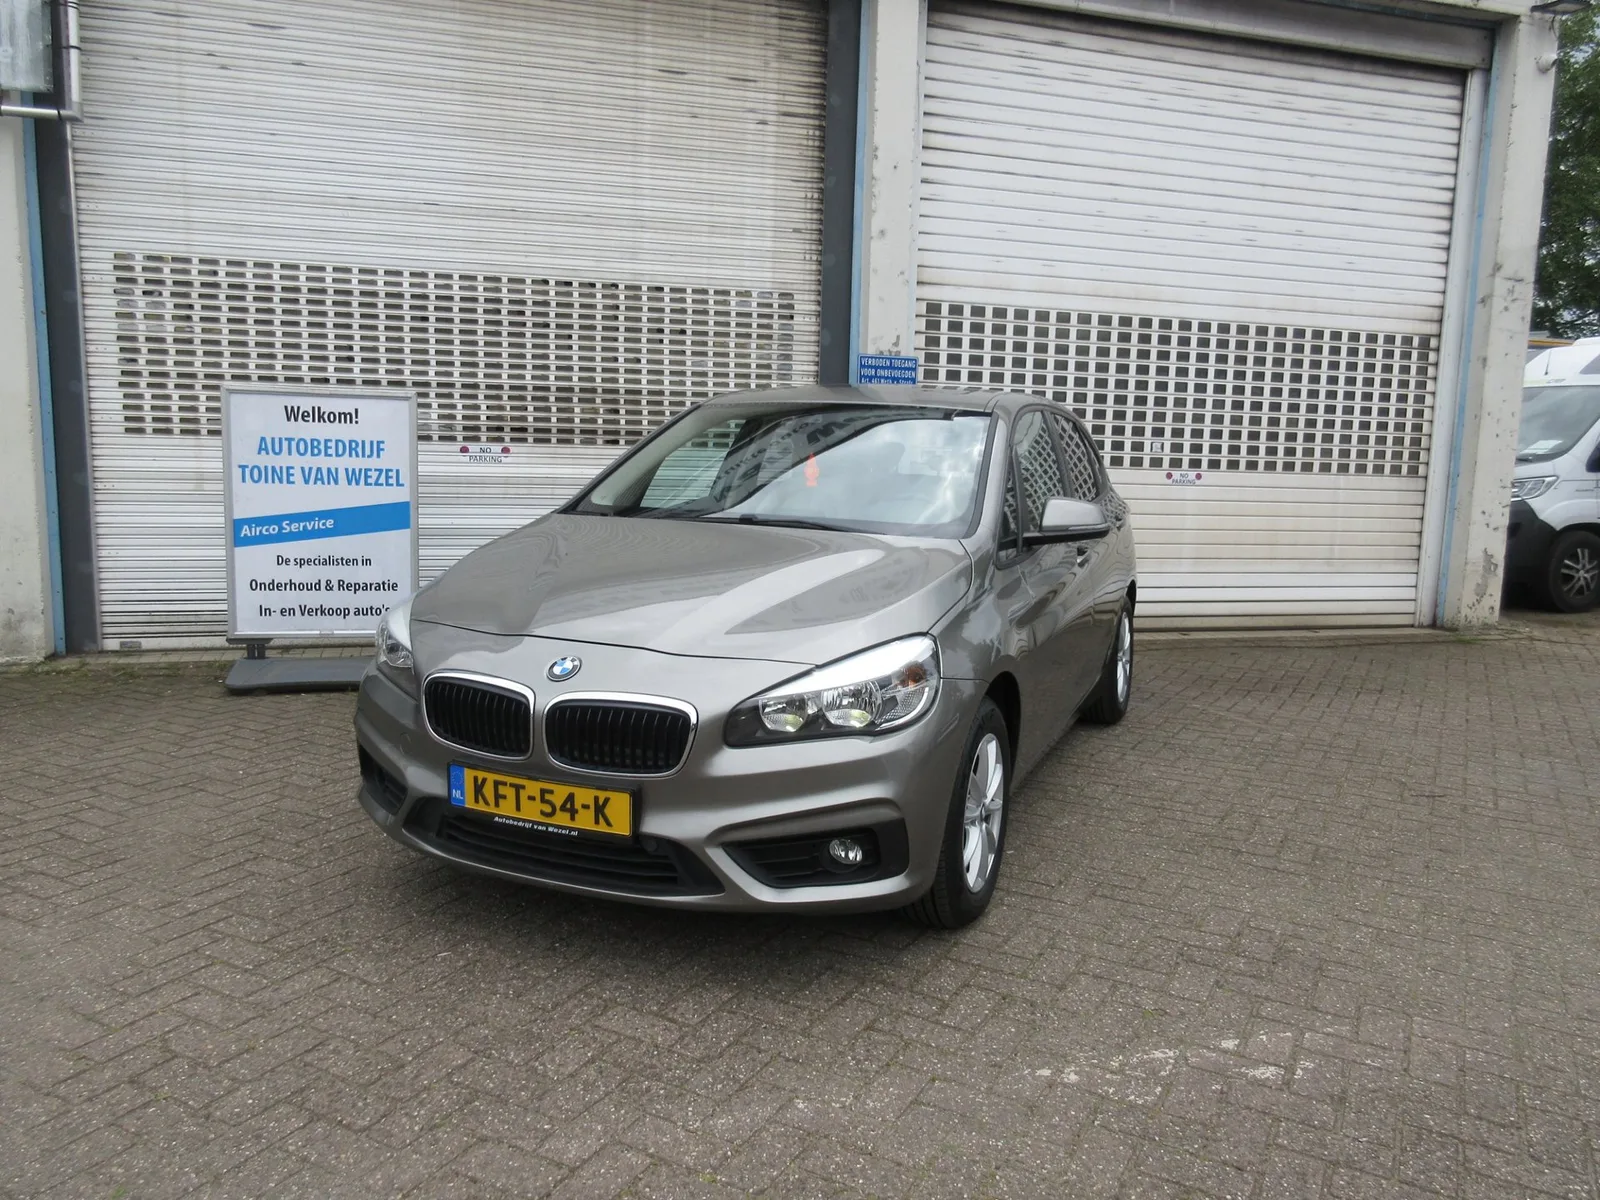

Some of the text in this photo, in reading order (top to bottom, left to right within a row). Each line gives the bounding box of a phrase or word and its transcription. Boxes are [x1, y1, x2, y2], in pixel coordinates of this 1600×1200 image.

[861, 357, 915, 368] VERBODEN TOEGANG
[861, 368, 875, 376] VOOR
[284, 405, 359, 425] Welkom!
[257, 436, 386, 459] AUTOBEDRIJF
[468, 455, 503, 463] PARKING
[237, 464, 405, 487] TOINE VAN WEZEL
[240, 517, 335, 537] Airco Service
[276, 554, 372, 569] De specialisten in
[249, 578, 399, 595] Onderhoud & Reparatie
[259, 604, 277, 617] In-
[280, 607, 296, 617] en
[299, 604, 351, 619] Verkoop
[452, 788, 464, 800] NL
[473, 775, 613, 828] KFT-54-K
[494, 816, 532, 829] Autobedrijf
[547, 826, 578, 836] Wezel.nl
